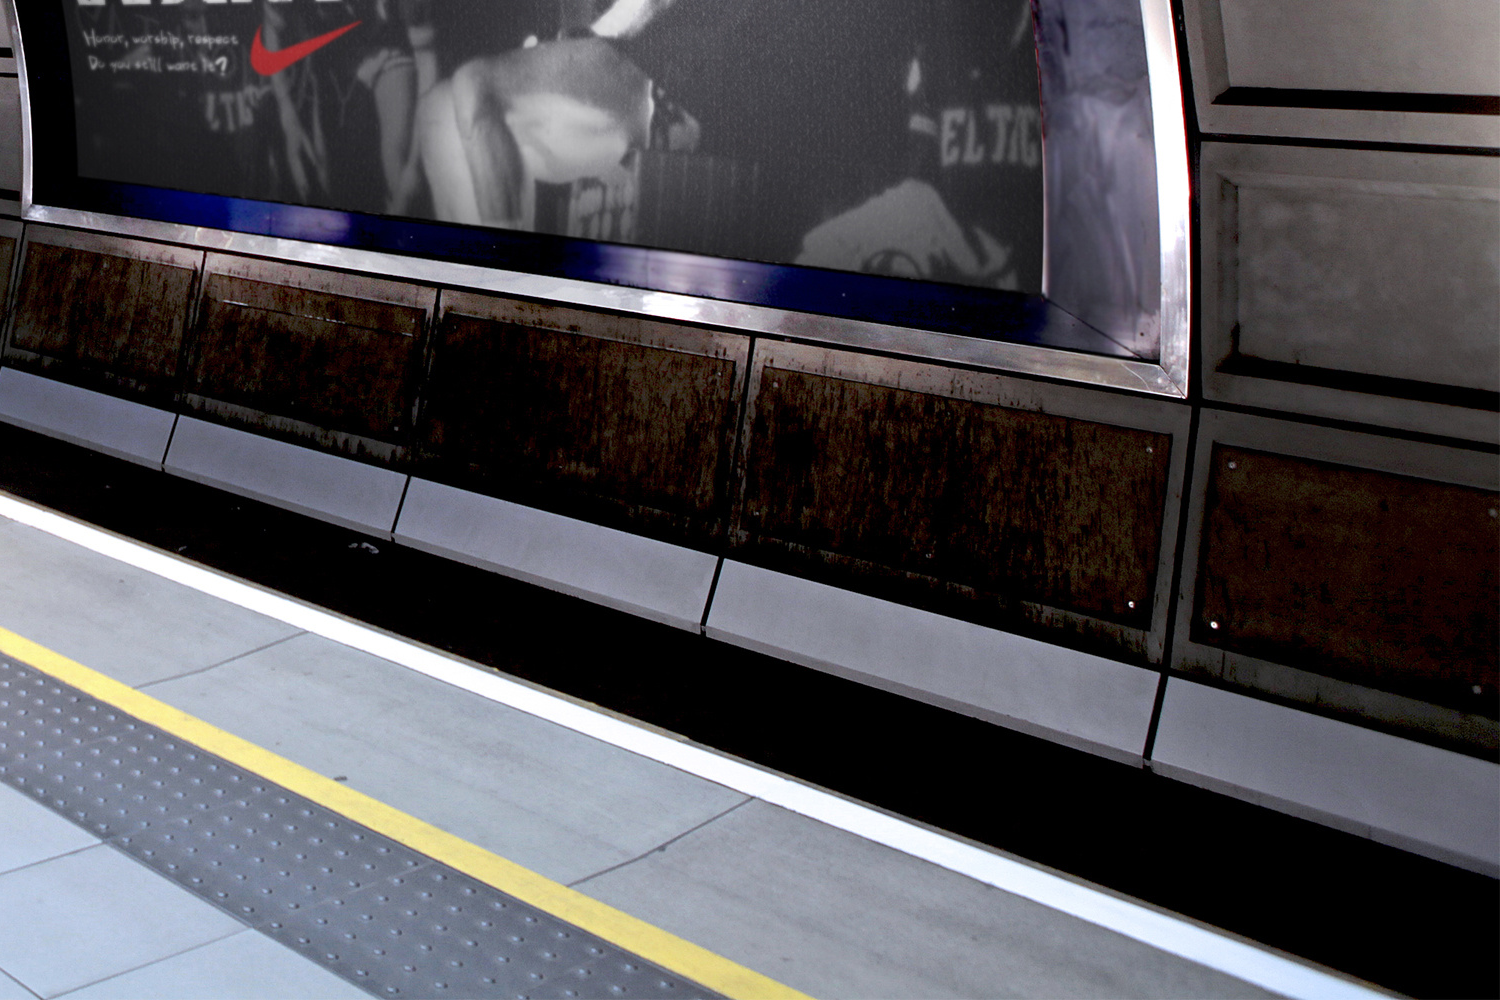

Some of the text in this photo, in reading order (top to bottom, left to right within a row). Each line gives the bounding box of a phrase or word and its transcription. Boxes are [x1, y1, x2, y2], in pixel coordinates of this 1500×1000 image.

[83, 28, 239, 49] Honor, worship, respect
[88, 55, 105, 71] Do
[109, 61, 131, 73] you
[135, 56, 162, 73] still
[167, 60, 198, 73] want
